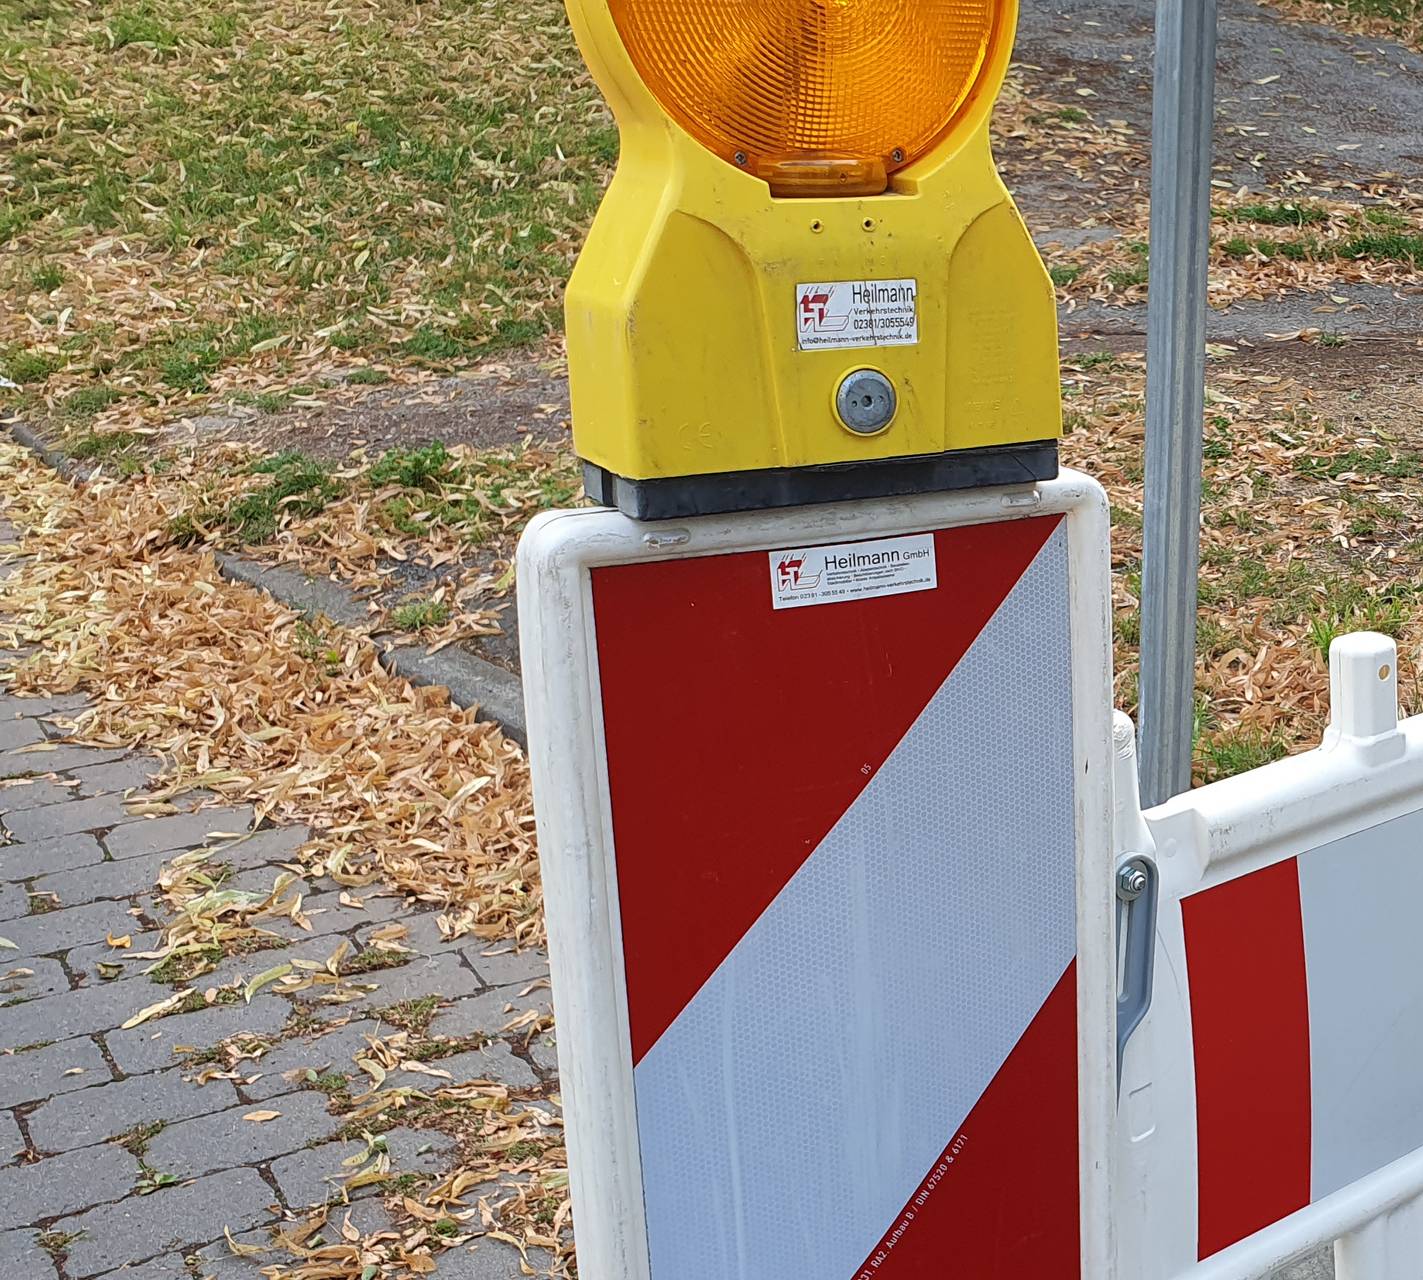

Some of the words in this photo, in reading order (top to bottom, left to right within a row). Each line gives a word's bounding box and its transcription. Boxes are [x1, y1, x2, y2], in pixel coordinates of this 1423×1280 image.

[852, 283, 914, 304] Heilmann
[854, 306, 914, 316] Verkehrstechnik
[854, 317, 914, 330] 02381/3055549
[825, 550, 900, 571] Heilmann
[903, 549, 930, 561] GmbH
[886, 1220, 909, 1249] Aufbau
[906, 1211, 915, 1220] B
[916, 1189, 930, 1206] DIN
[927, 1163, 948, 1190] 67520
[945, 1155, 954, 1163] &
[952, 1134, 969, 1154] 6171
